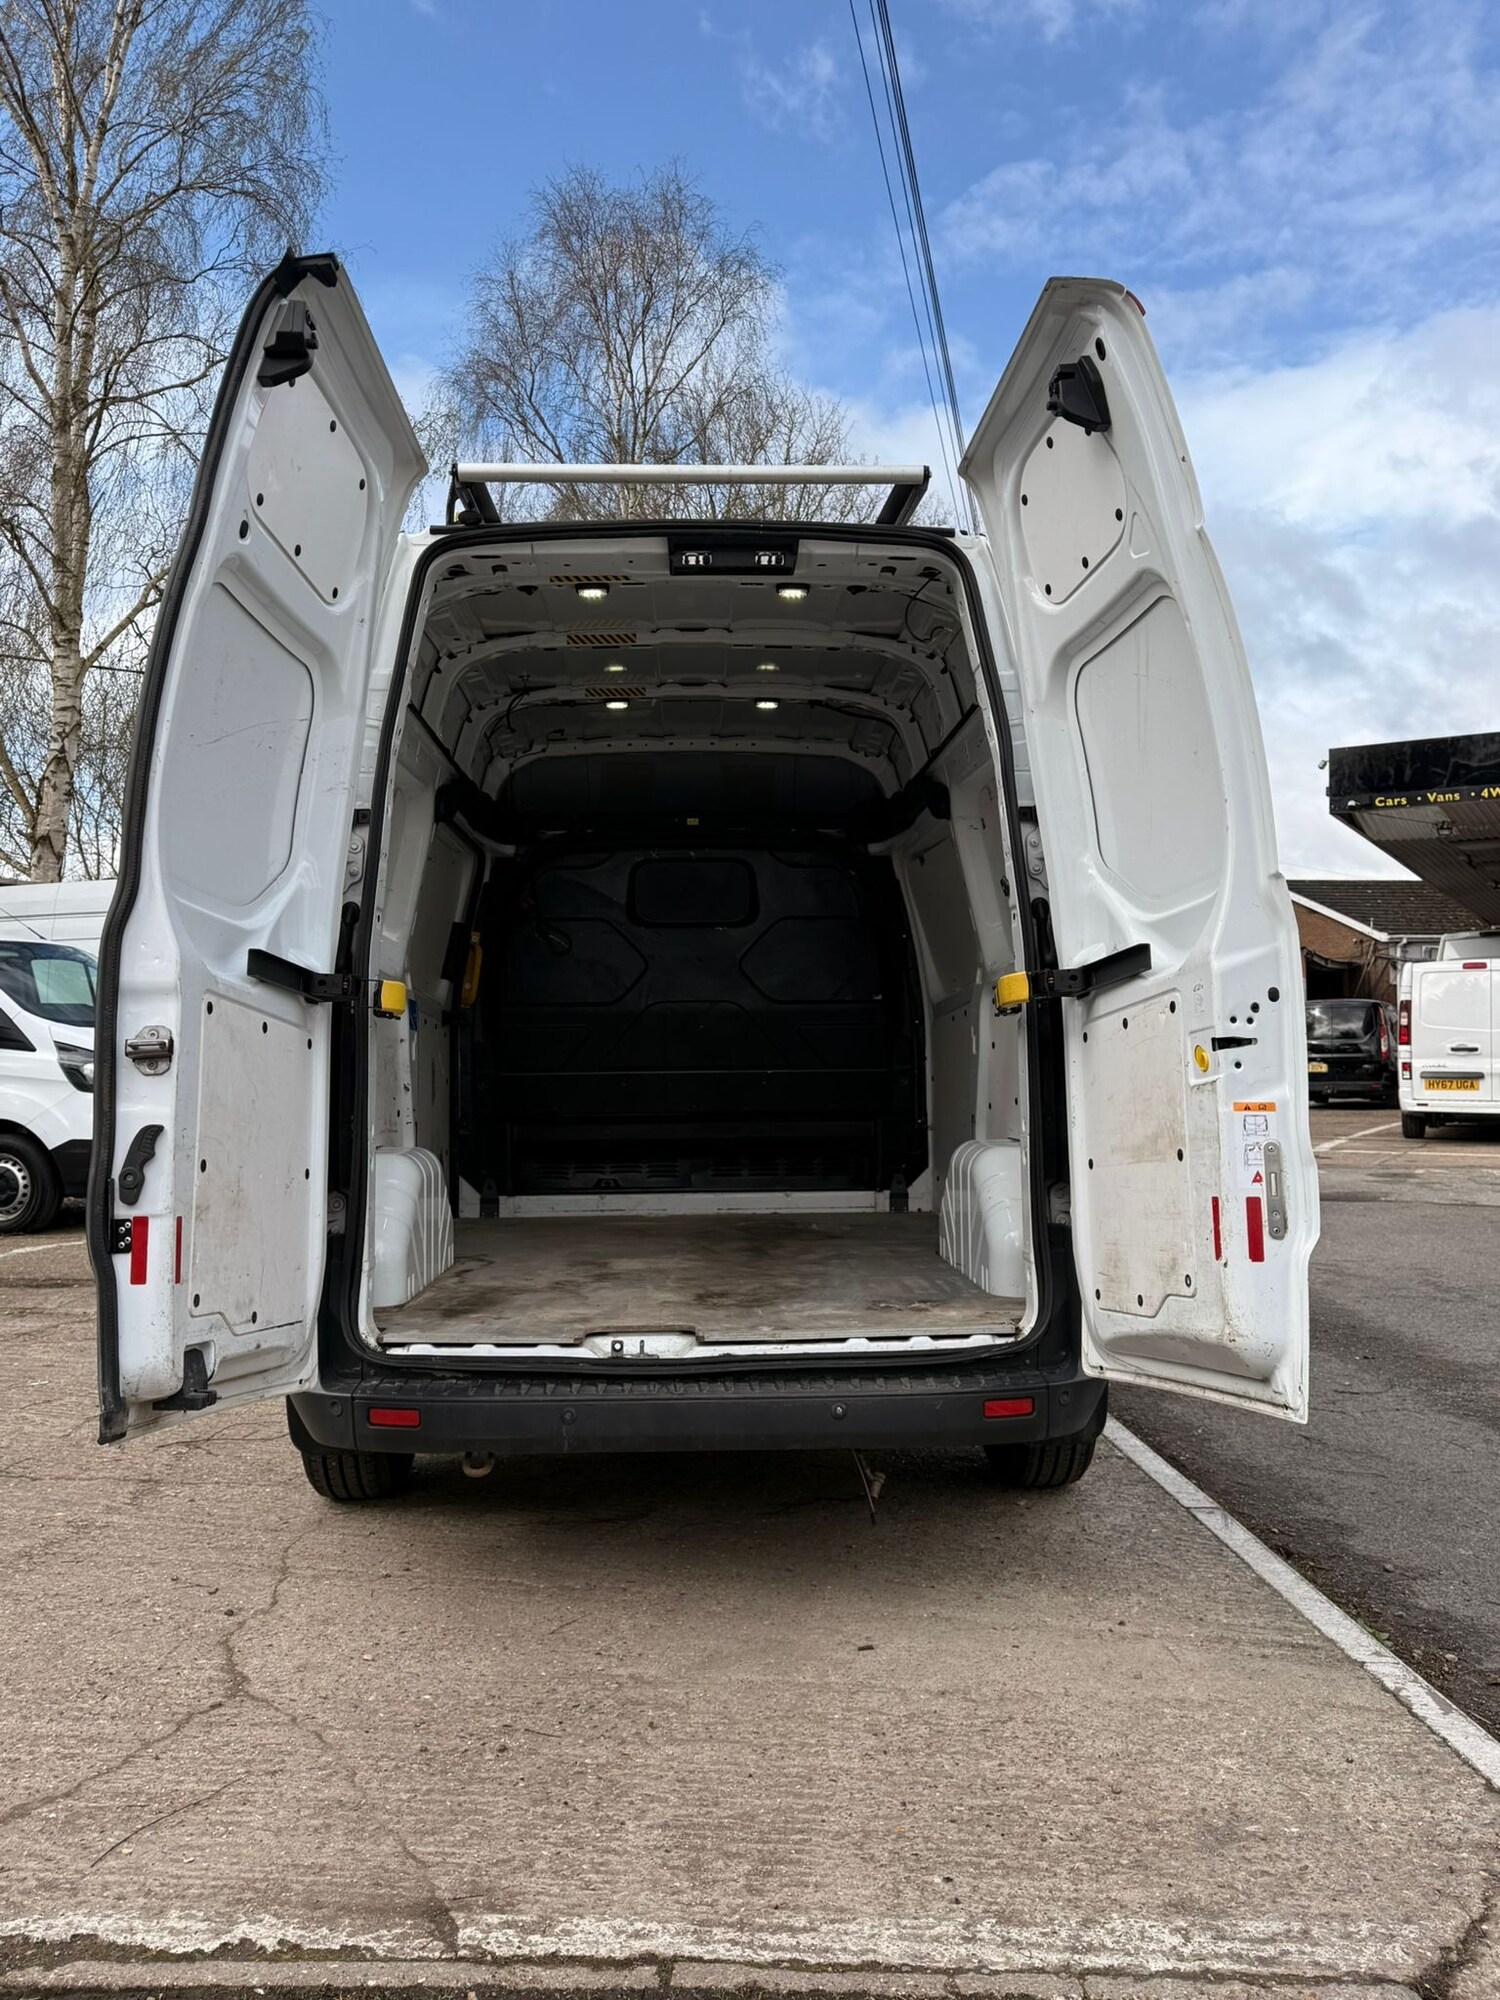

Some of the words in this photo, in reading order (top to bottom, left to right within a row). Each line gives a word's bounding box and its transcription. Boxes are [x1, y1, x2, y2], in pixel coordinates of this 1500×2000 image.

[1375, 796, 1407, 807] Cars
[1426, 791, 1461, 803] Vans
[1428, 1080, 1454, 1090] HY67
[1456, 1080, 1475, 1090] UGA
